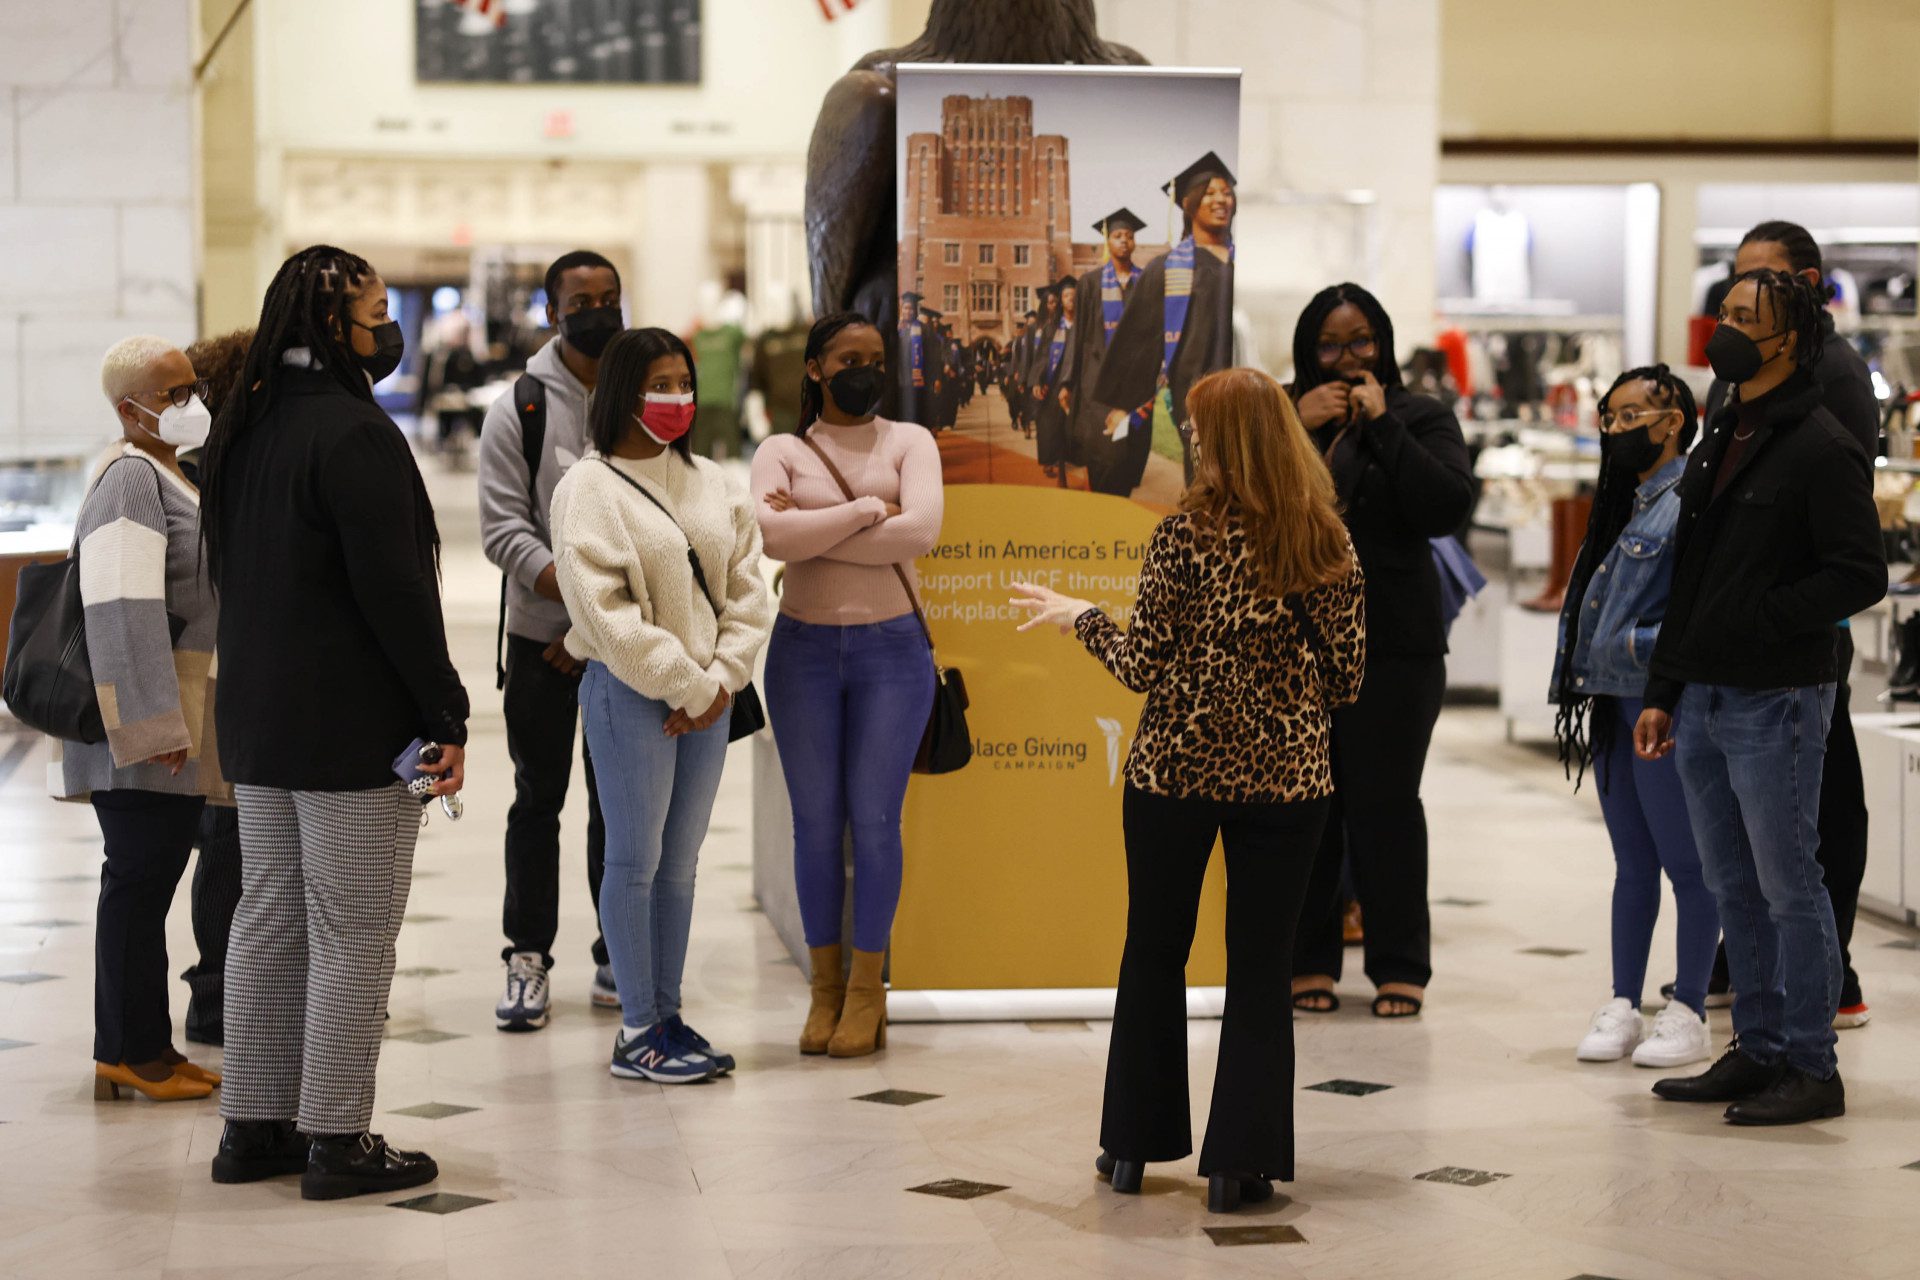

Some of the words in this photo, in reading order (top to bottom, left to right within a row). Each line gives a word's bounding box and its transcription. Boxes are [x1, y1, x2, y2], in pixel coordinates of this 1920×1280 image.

[925, 541, 971, 559] vest
[978, 539, 996, 559] in
[1002, 540, 1106, 560] America's
[1114, 540, 1147, 560] Fut
[1000, 569, 1062, 590] UNCF
[1067, 571, 1137, 596] throug
[1024, 737, 1087, 762] Giving
[994, 761, 1076, 770] CAMPAIGN
